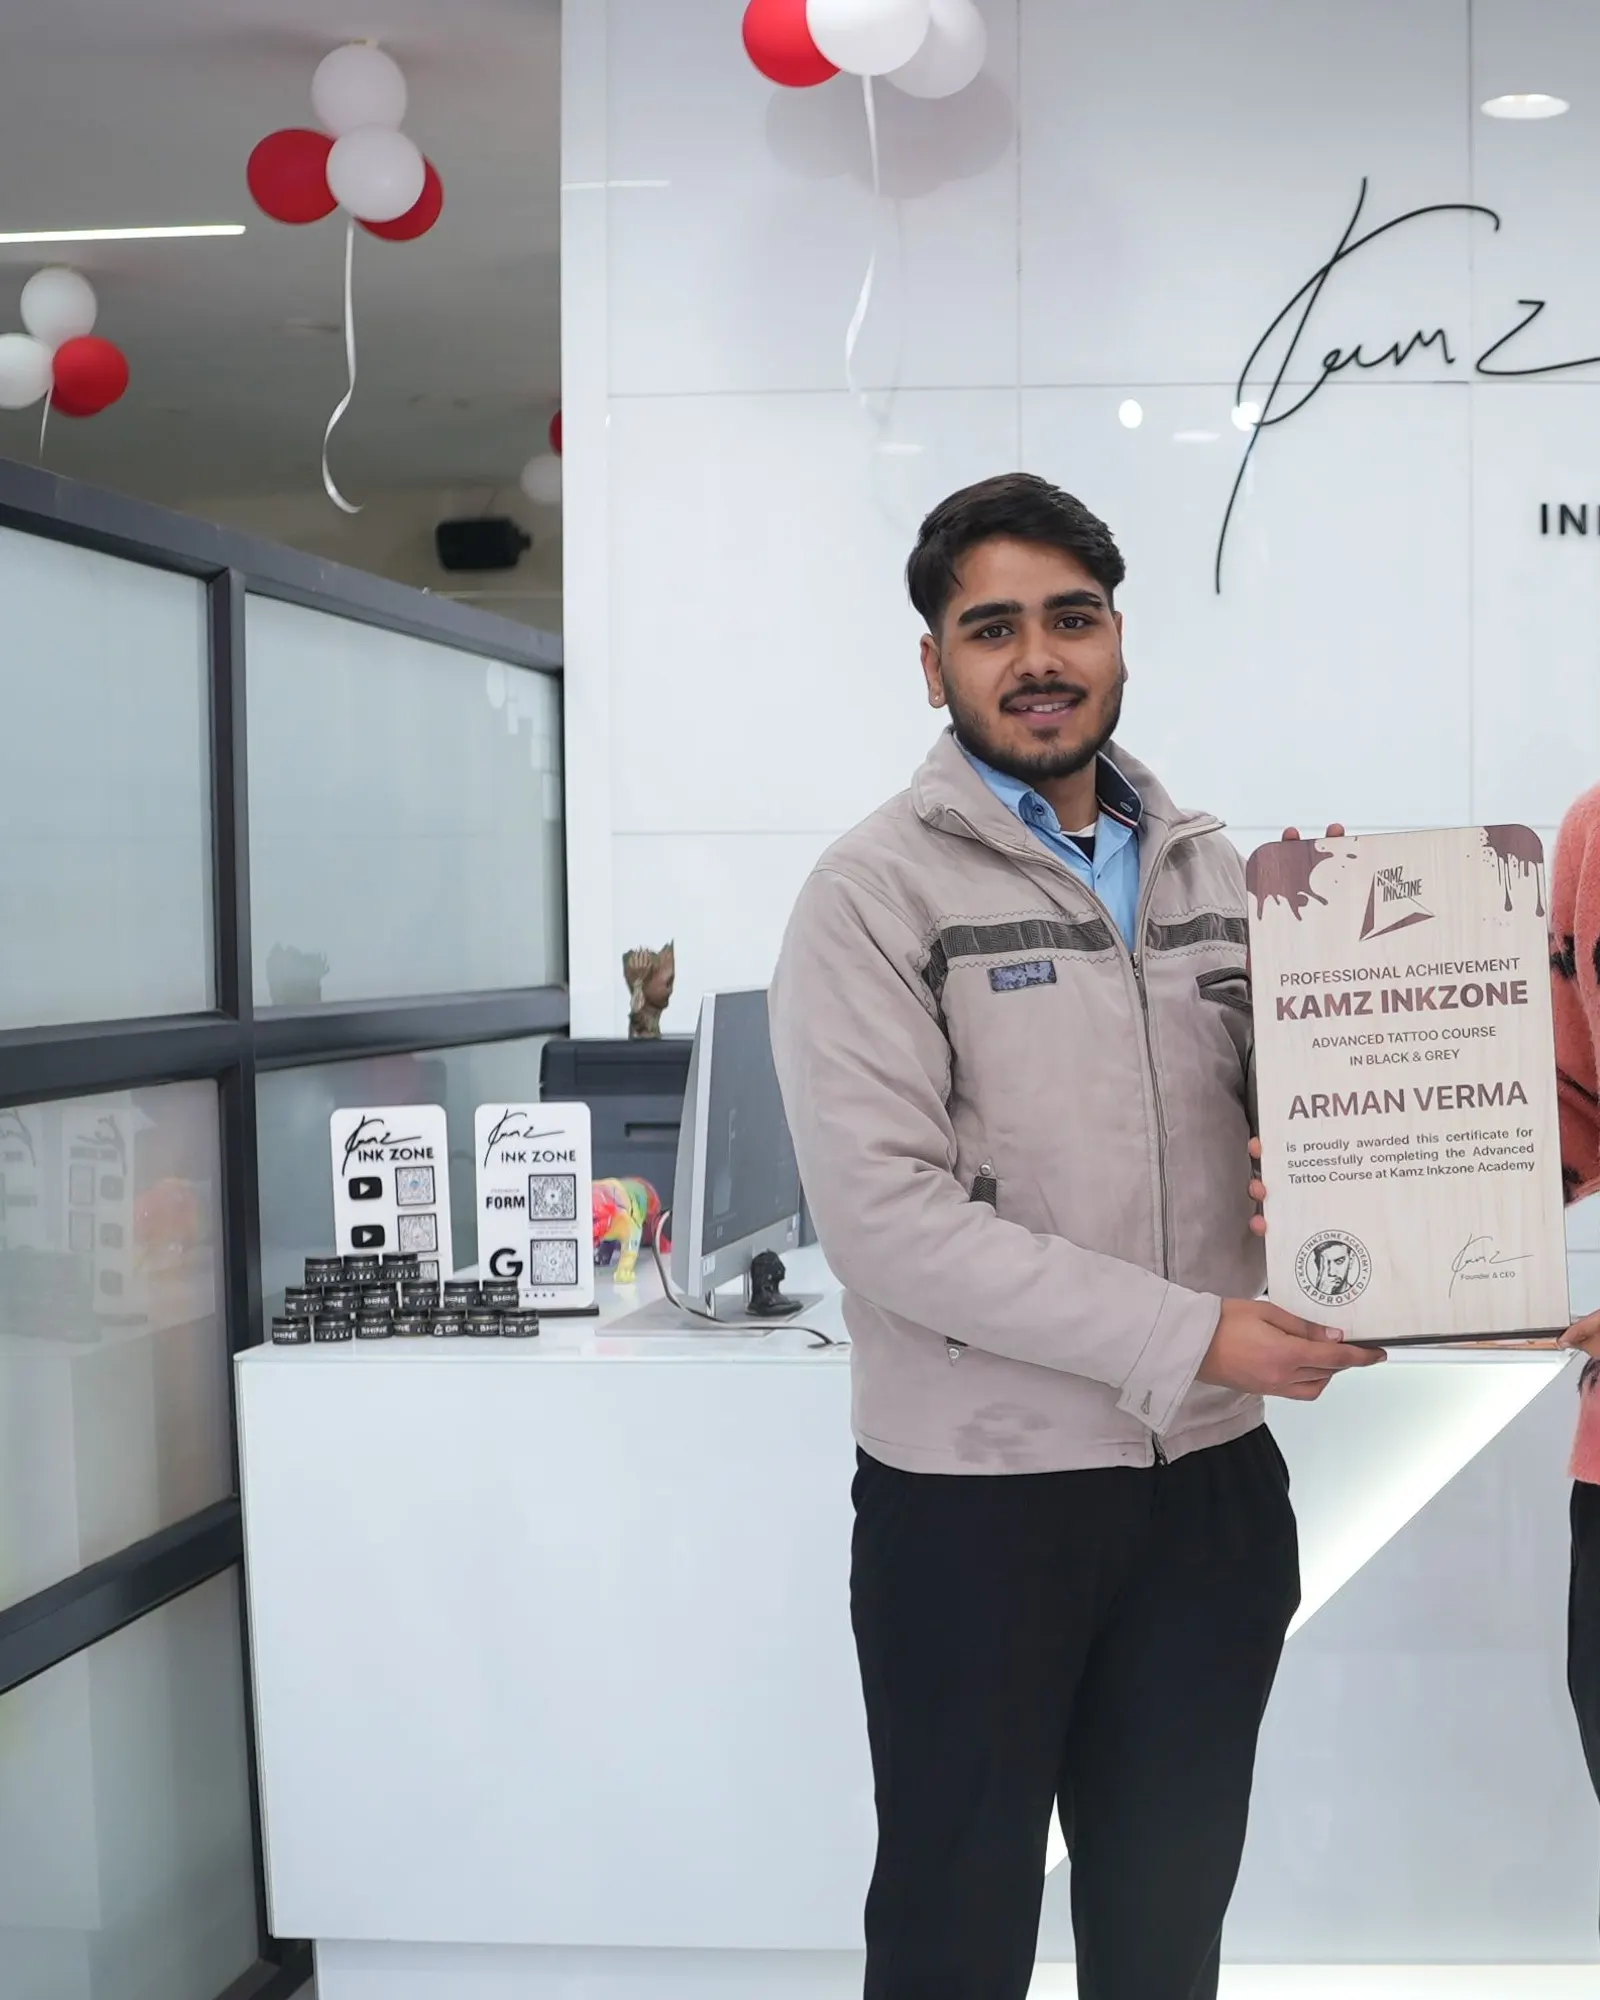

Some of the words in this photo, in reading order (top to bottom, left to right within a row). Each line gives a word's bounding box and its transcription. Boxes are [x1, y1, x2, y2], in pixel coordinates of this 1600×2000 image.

[1541, 503, 1600, 536] IN
[1383, 878, 1422, 902] INKZONE
[1280, 966, 1401, 986] PROFESSIONAL
[1405, 957, 1520, 978] ACHIEVEMENT
[1275, 991, 1373, 1021] KAMZ
[1381, 980, 1528, 1013] INKZONE
[1311, 1033, 1384, 1049] ADVANCED
[1387, 1030, 1439, 1044] TATTOO
[1441, 1026, 1497, 1039] COURSE
[1349, 1055, 1363, 1066] IN
[1366, 1052, 1410, 1065] BLACK
[1412, 1051, 1421, 1062] &
[1424, 1049, 1460, 1061] GREY
[1288, 1088, 1405, 1120] ARMAN
[1412, 1080, 1528, 1111] VERMA
[1286, 1142, 1297, 1153] is
[1303, 1138, 1350, 1154] proudly
[1356, 1134, 1410, 1148] awarded
[1416, 1132, 1439, 1145] this
[1446, 1128, 1509, 1143] certificate
[1516, 1127, 1534, 1139] for
[358, 1149, 385, 1163] INK
[390, 1147, 435, 1161] ZONE
[501, 1150, 527, 1163] INK
[532, 1149, 576, 1163] ZONE
[1287, 1153, 1363, 1169] successfully
[1370, 1148, 1439, 1165] completing
[1445, 1147, 1466, 1159] the
[1472, 1143, 1534, 1158] Advanced
[1288, 1172, 1327, 1184] Tattoo
[1329, 1169, 1373, 1182] Course
[1375, 1168, 1388, 1179] at
[1390, 1166, 1425, 1178] Kamz
[1426, 1163, 1475, 1176] Inkzone
[1477, 1160, 1535, 1174] Academy
[486, 1195, 525, 1210] FORM
[489, 1247, 523, 1277] G
[1305, 1232, 1342, 1251] INKZONE
[1343, 1235, 1369, 1273] ACADEMY
[1303, 1281, 1364, 1304] APPROVED
